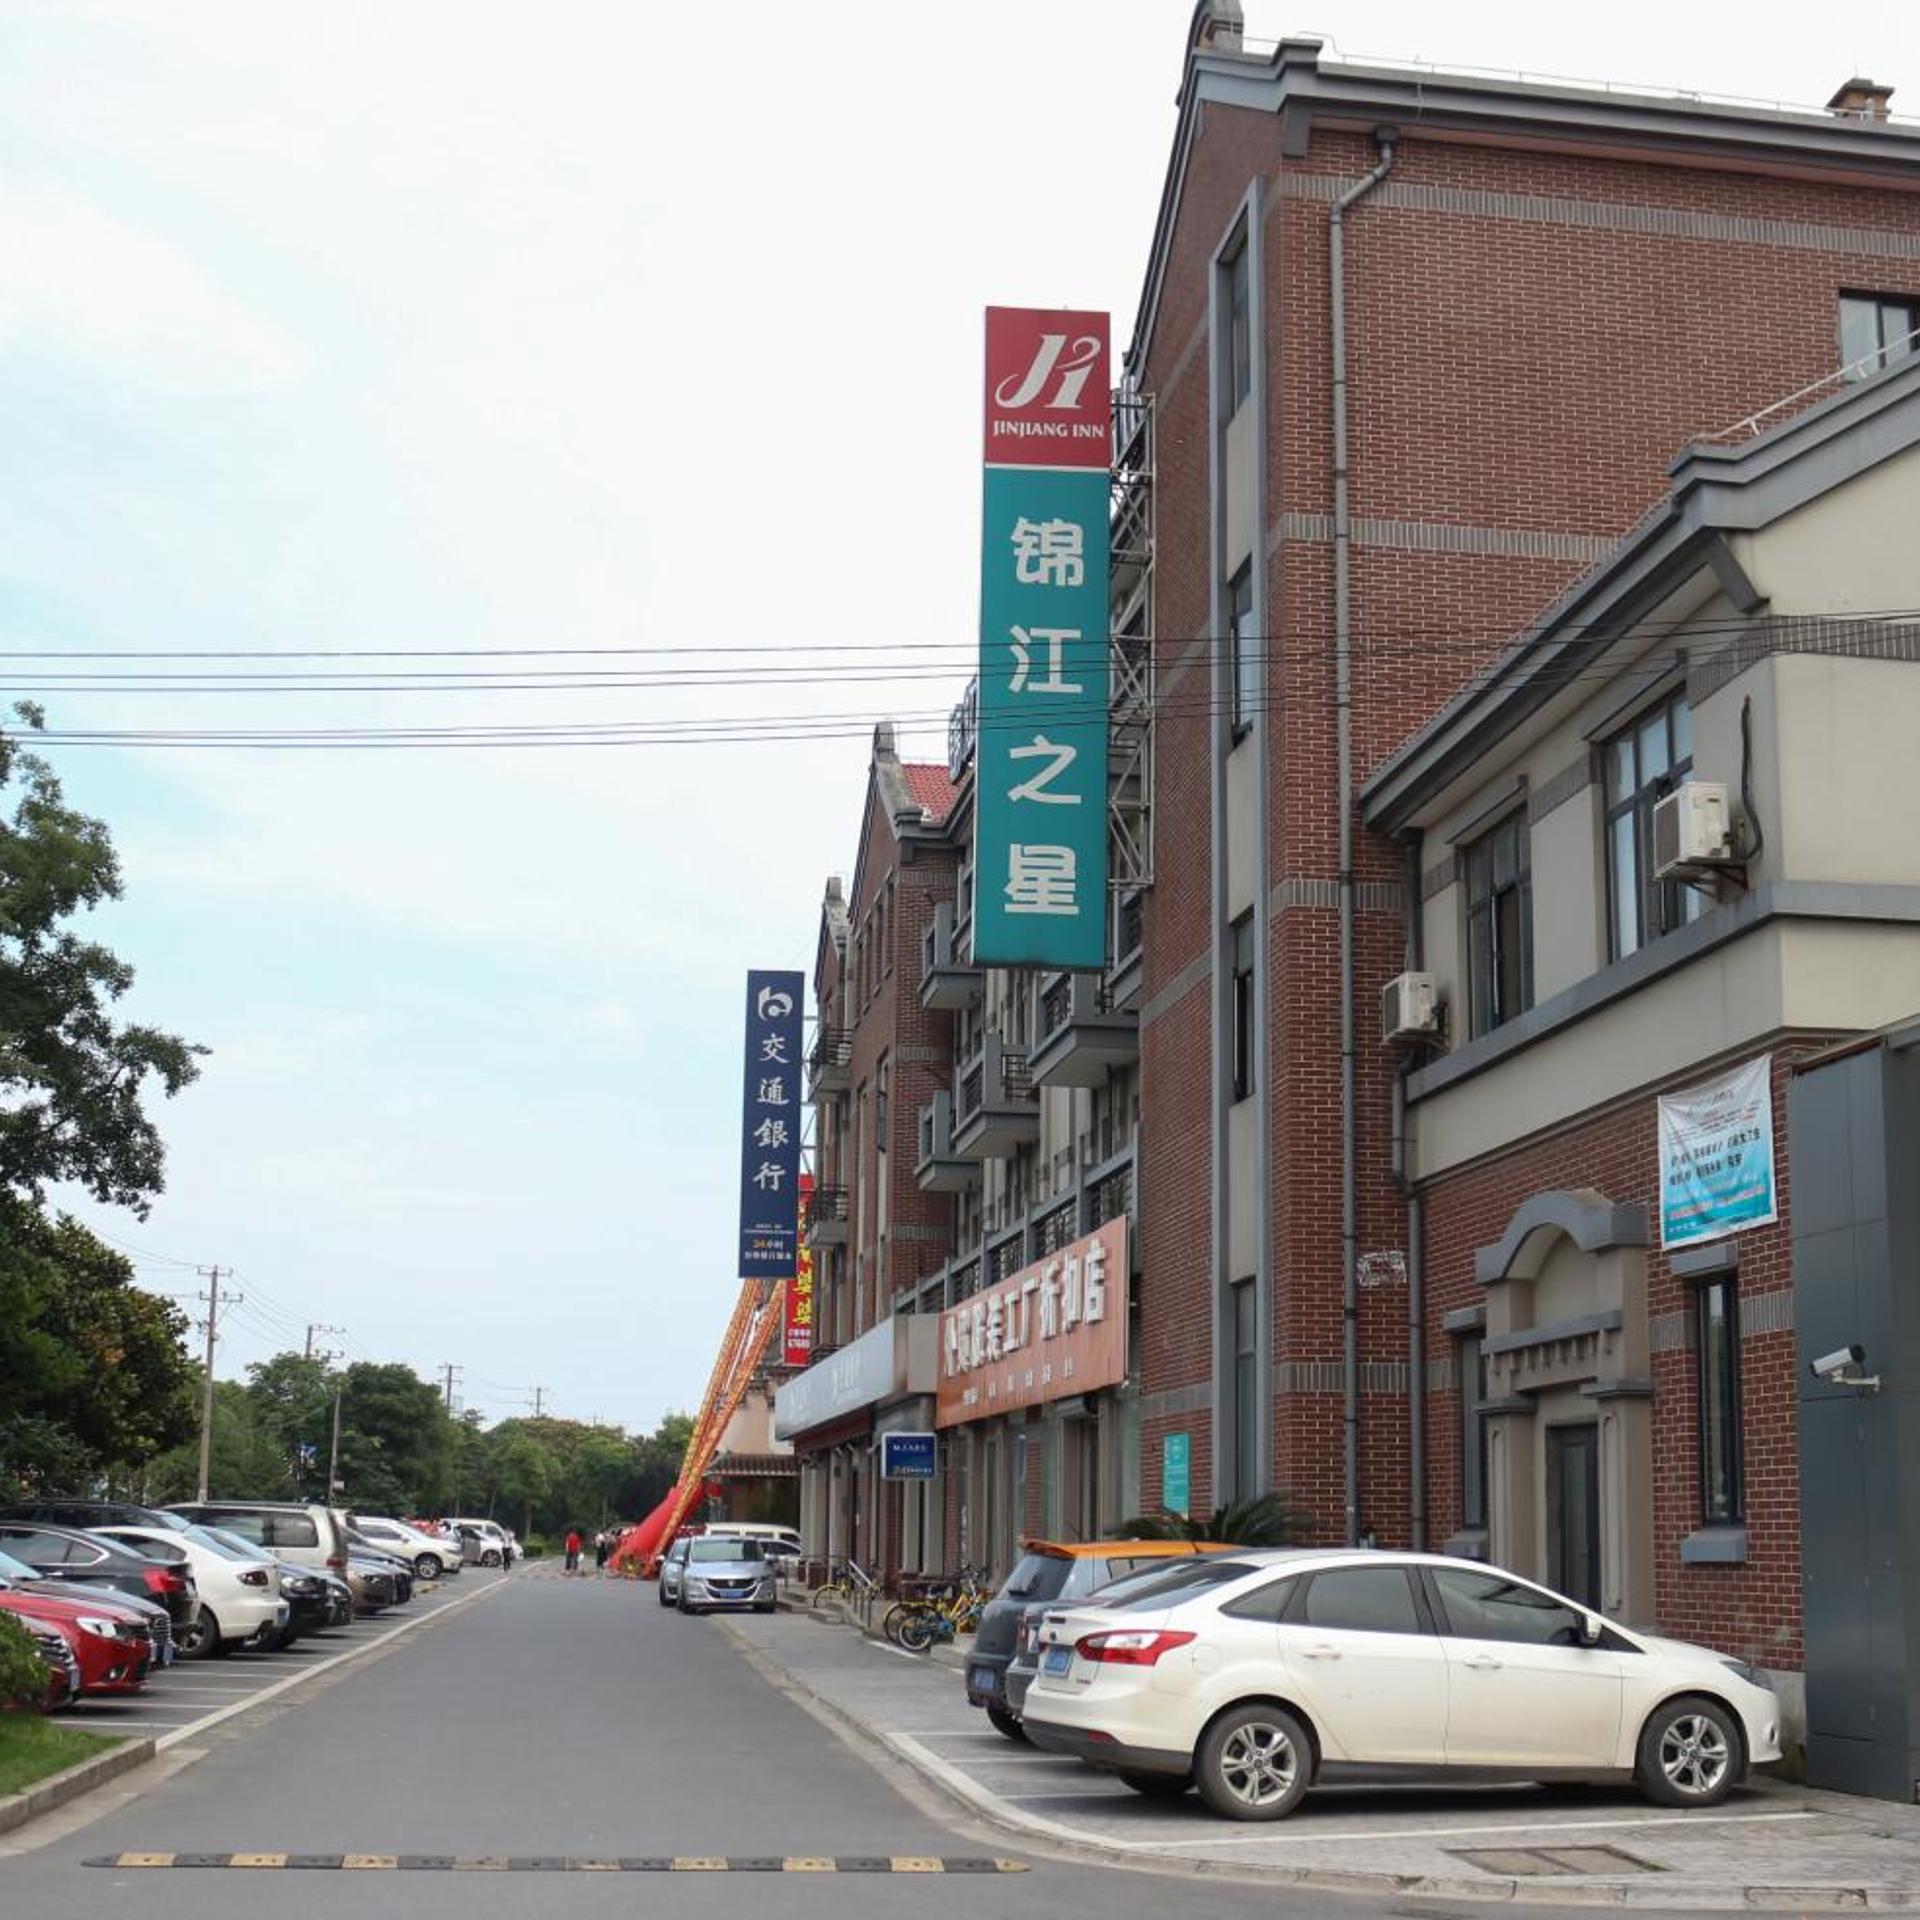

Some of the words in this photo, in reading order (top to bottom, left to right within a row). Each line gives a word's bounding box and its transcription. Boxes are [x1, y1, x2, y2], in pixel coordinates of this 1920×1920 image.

[994, 420, 1068, 438] JINJIANG
[1072, 424, 1105, 438] INN
[1004, 516, 1085, 916] 锦江之星
